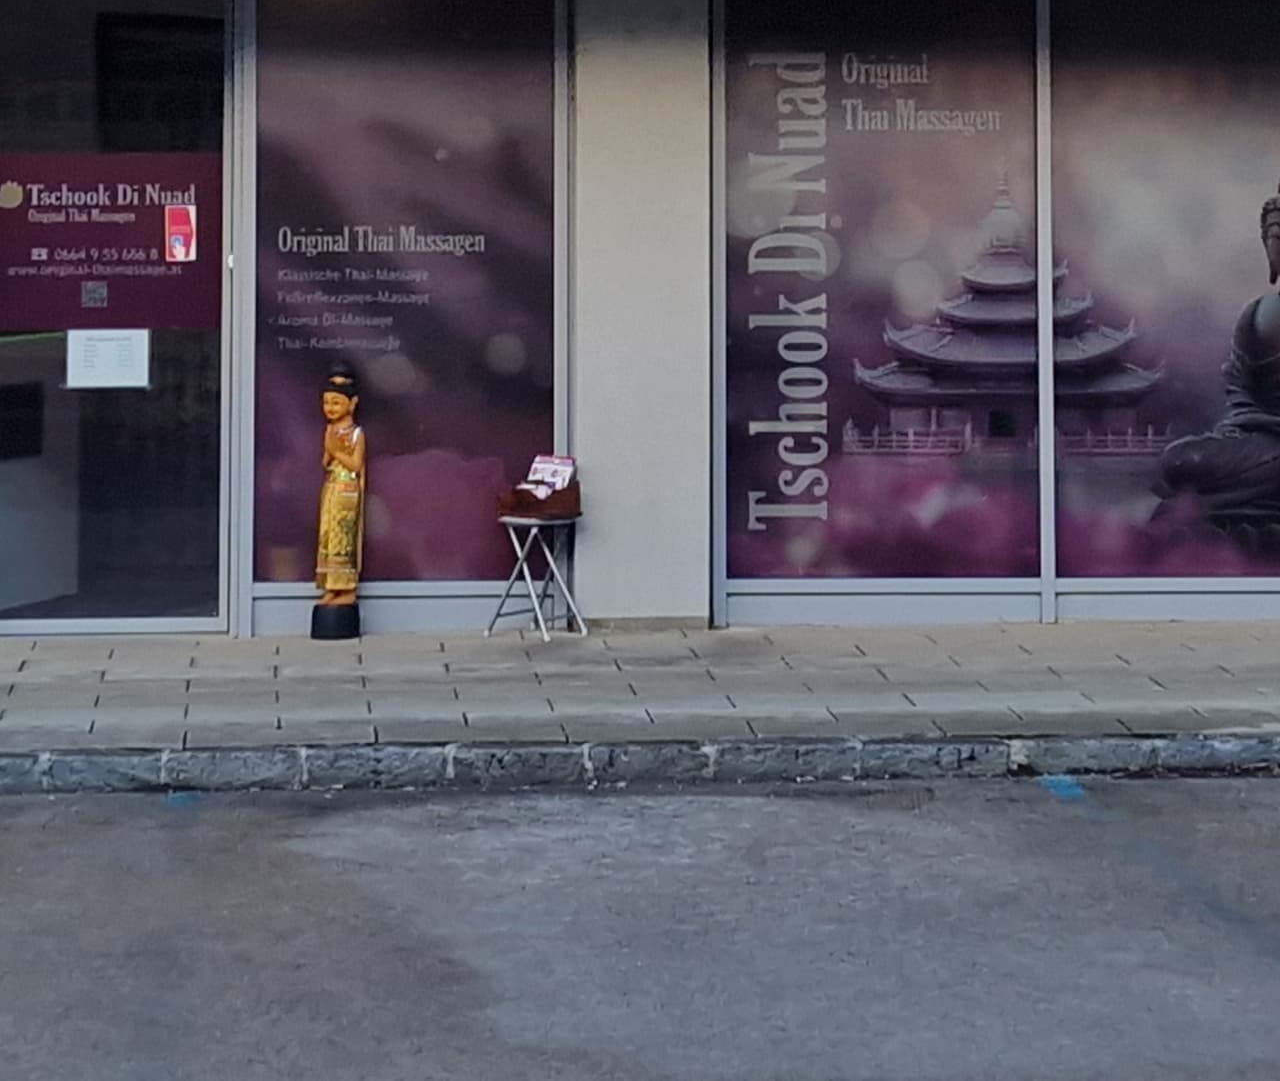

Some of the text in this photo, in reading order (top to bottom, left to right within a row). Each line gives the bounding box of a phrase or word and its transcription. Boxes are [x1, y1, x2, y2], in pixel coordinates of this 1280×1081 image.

[841, 52, 929, 88] Original
[840, 98, 1003, 136] Thai Massagen
[26, 182, 197, 207] Tschook Di Nuad
[277, 225, 486, 257] Original Thai Massagen
[747, 51, 829, 531] Tschook Di Nuad
